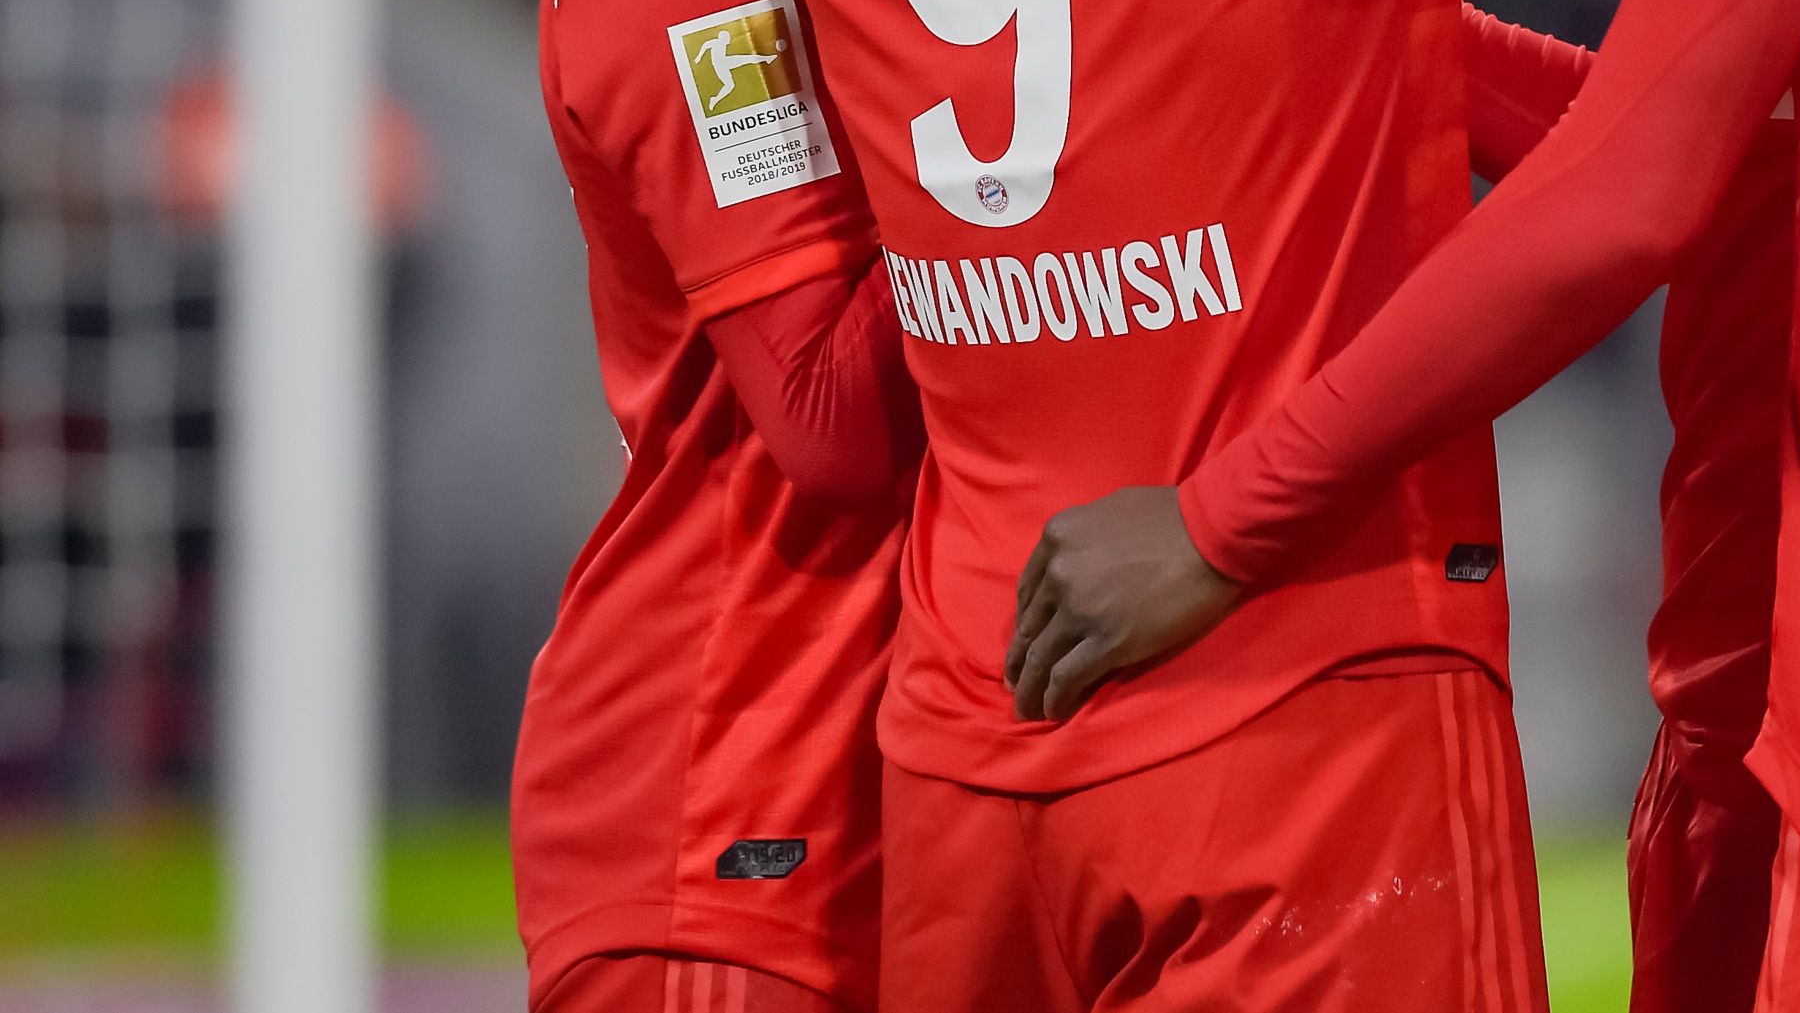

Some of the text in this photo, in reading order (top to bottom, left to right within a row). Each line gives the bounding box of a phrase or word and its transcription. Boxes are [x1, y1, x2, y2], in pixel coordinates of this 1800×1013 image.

[708, 101, 808, 140] BUNDESLIGA
[721, 145, 822, 182] FUSSBALLMEISTER
[737, 140, 801, 165] DEUTSCHER
[747, 162, 806, 186] 2018/2019
